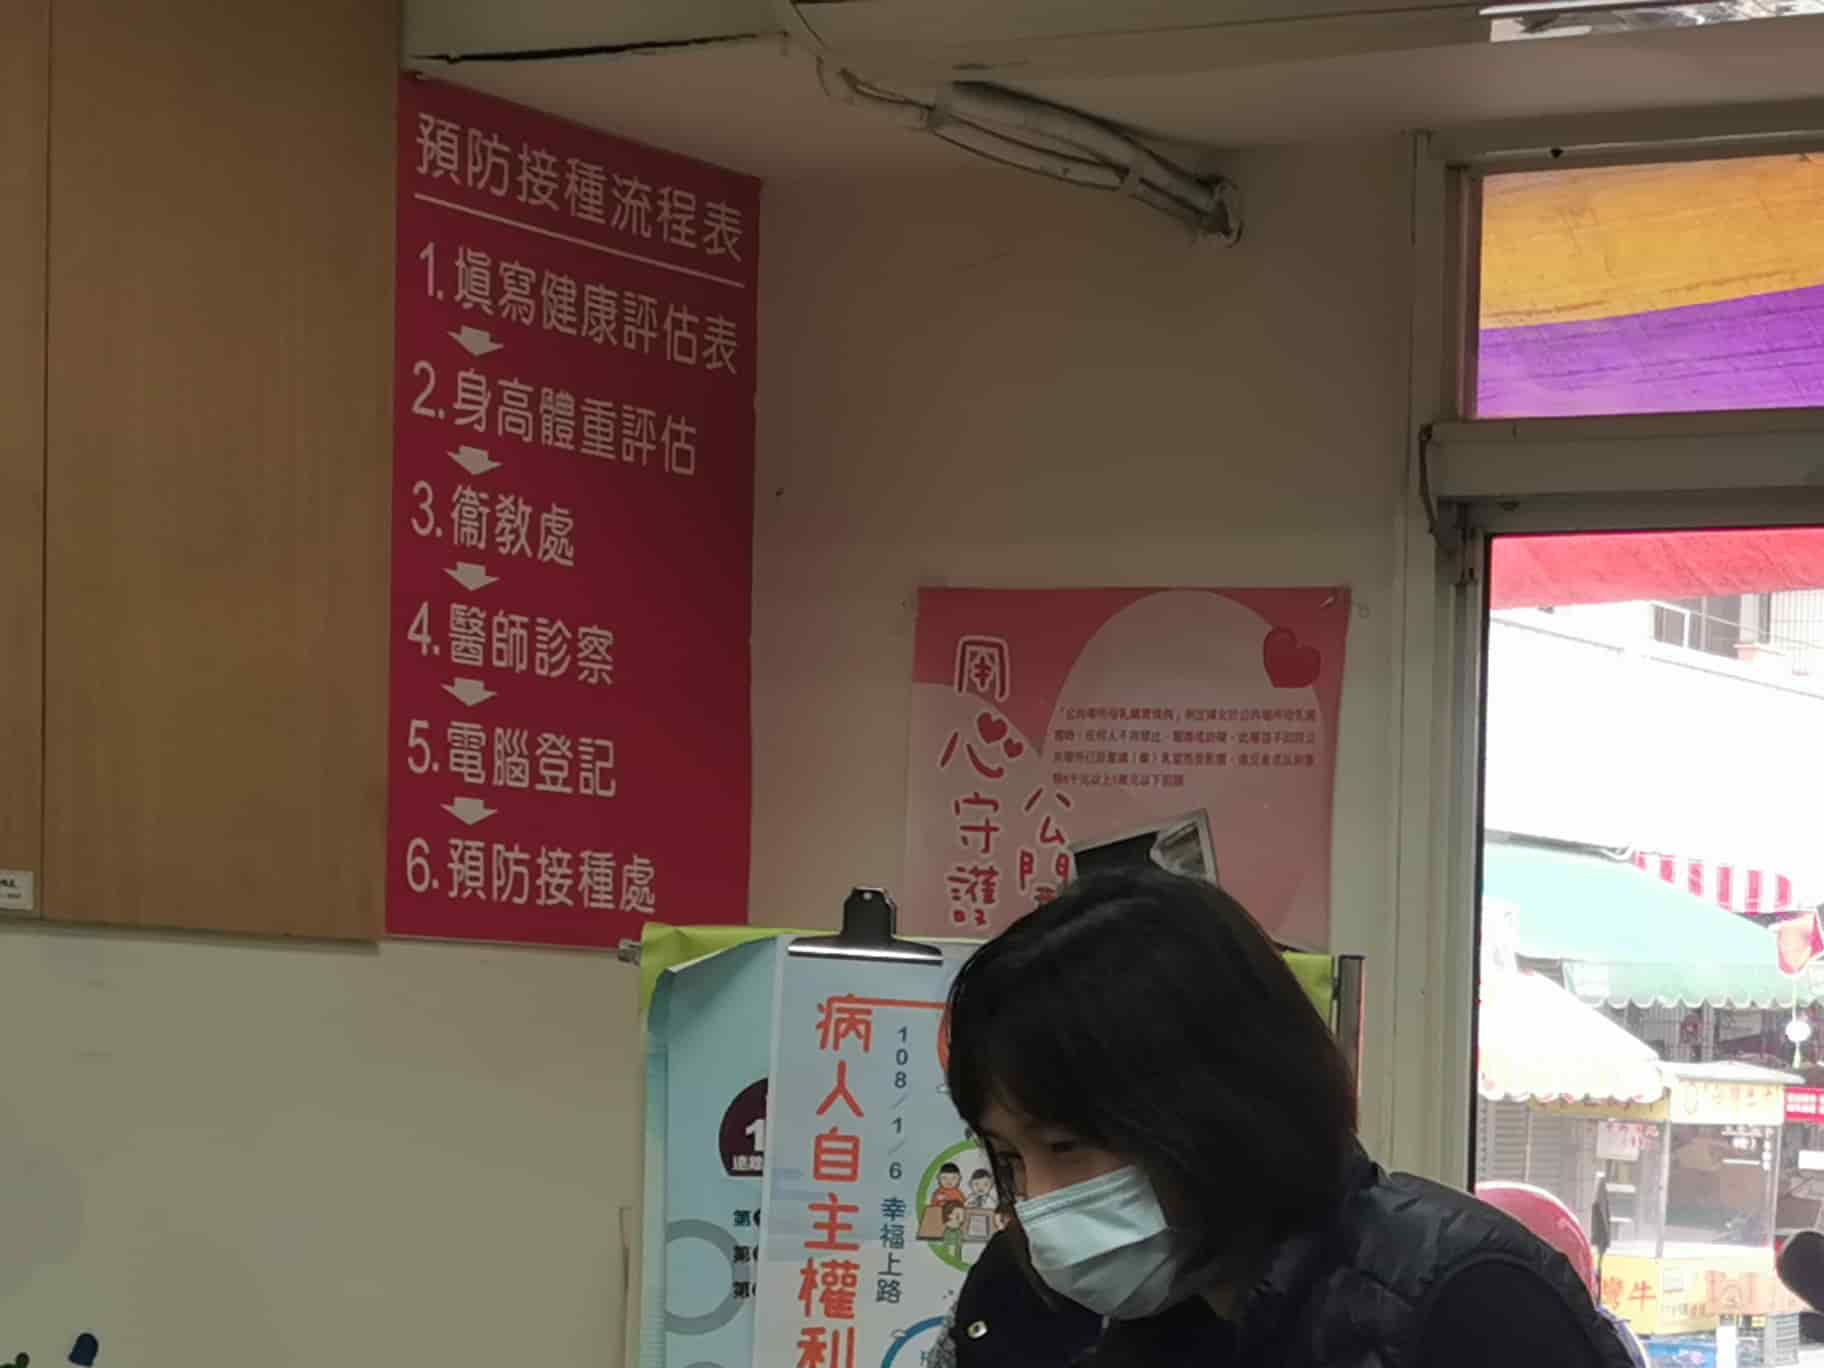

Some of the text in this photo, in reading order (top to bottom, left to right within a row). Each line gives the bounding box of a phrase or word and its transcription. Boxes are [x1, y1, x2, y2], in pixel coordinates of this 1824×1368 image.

[415, 113, 743, 263] 預防接種流程表
[411, 361, 697, 476] 2.身高體重評估
[407, 602, 615, 686] 4.醫師診察
[407, 720, 616, 797] 5.電腦登記
[405, 838, 656, 914] 6.預防接種處
[876, 1197, 907, 1304] 幸福上路
